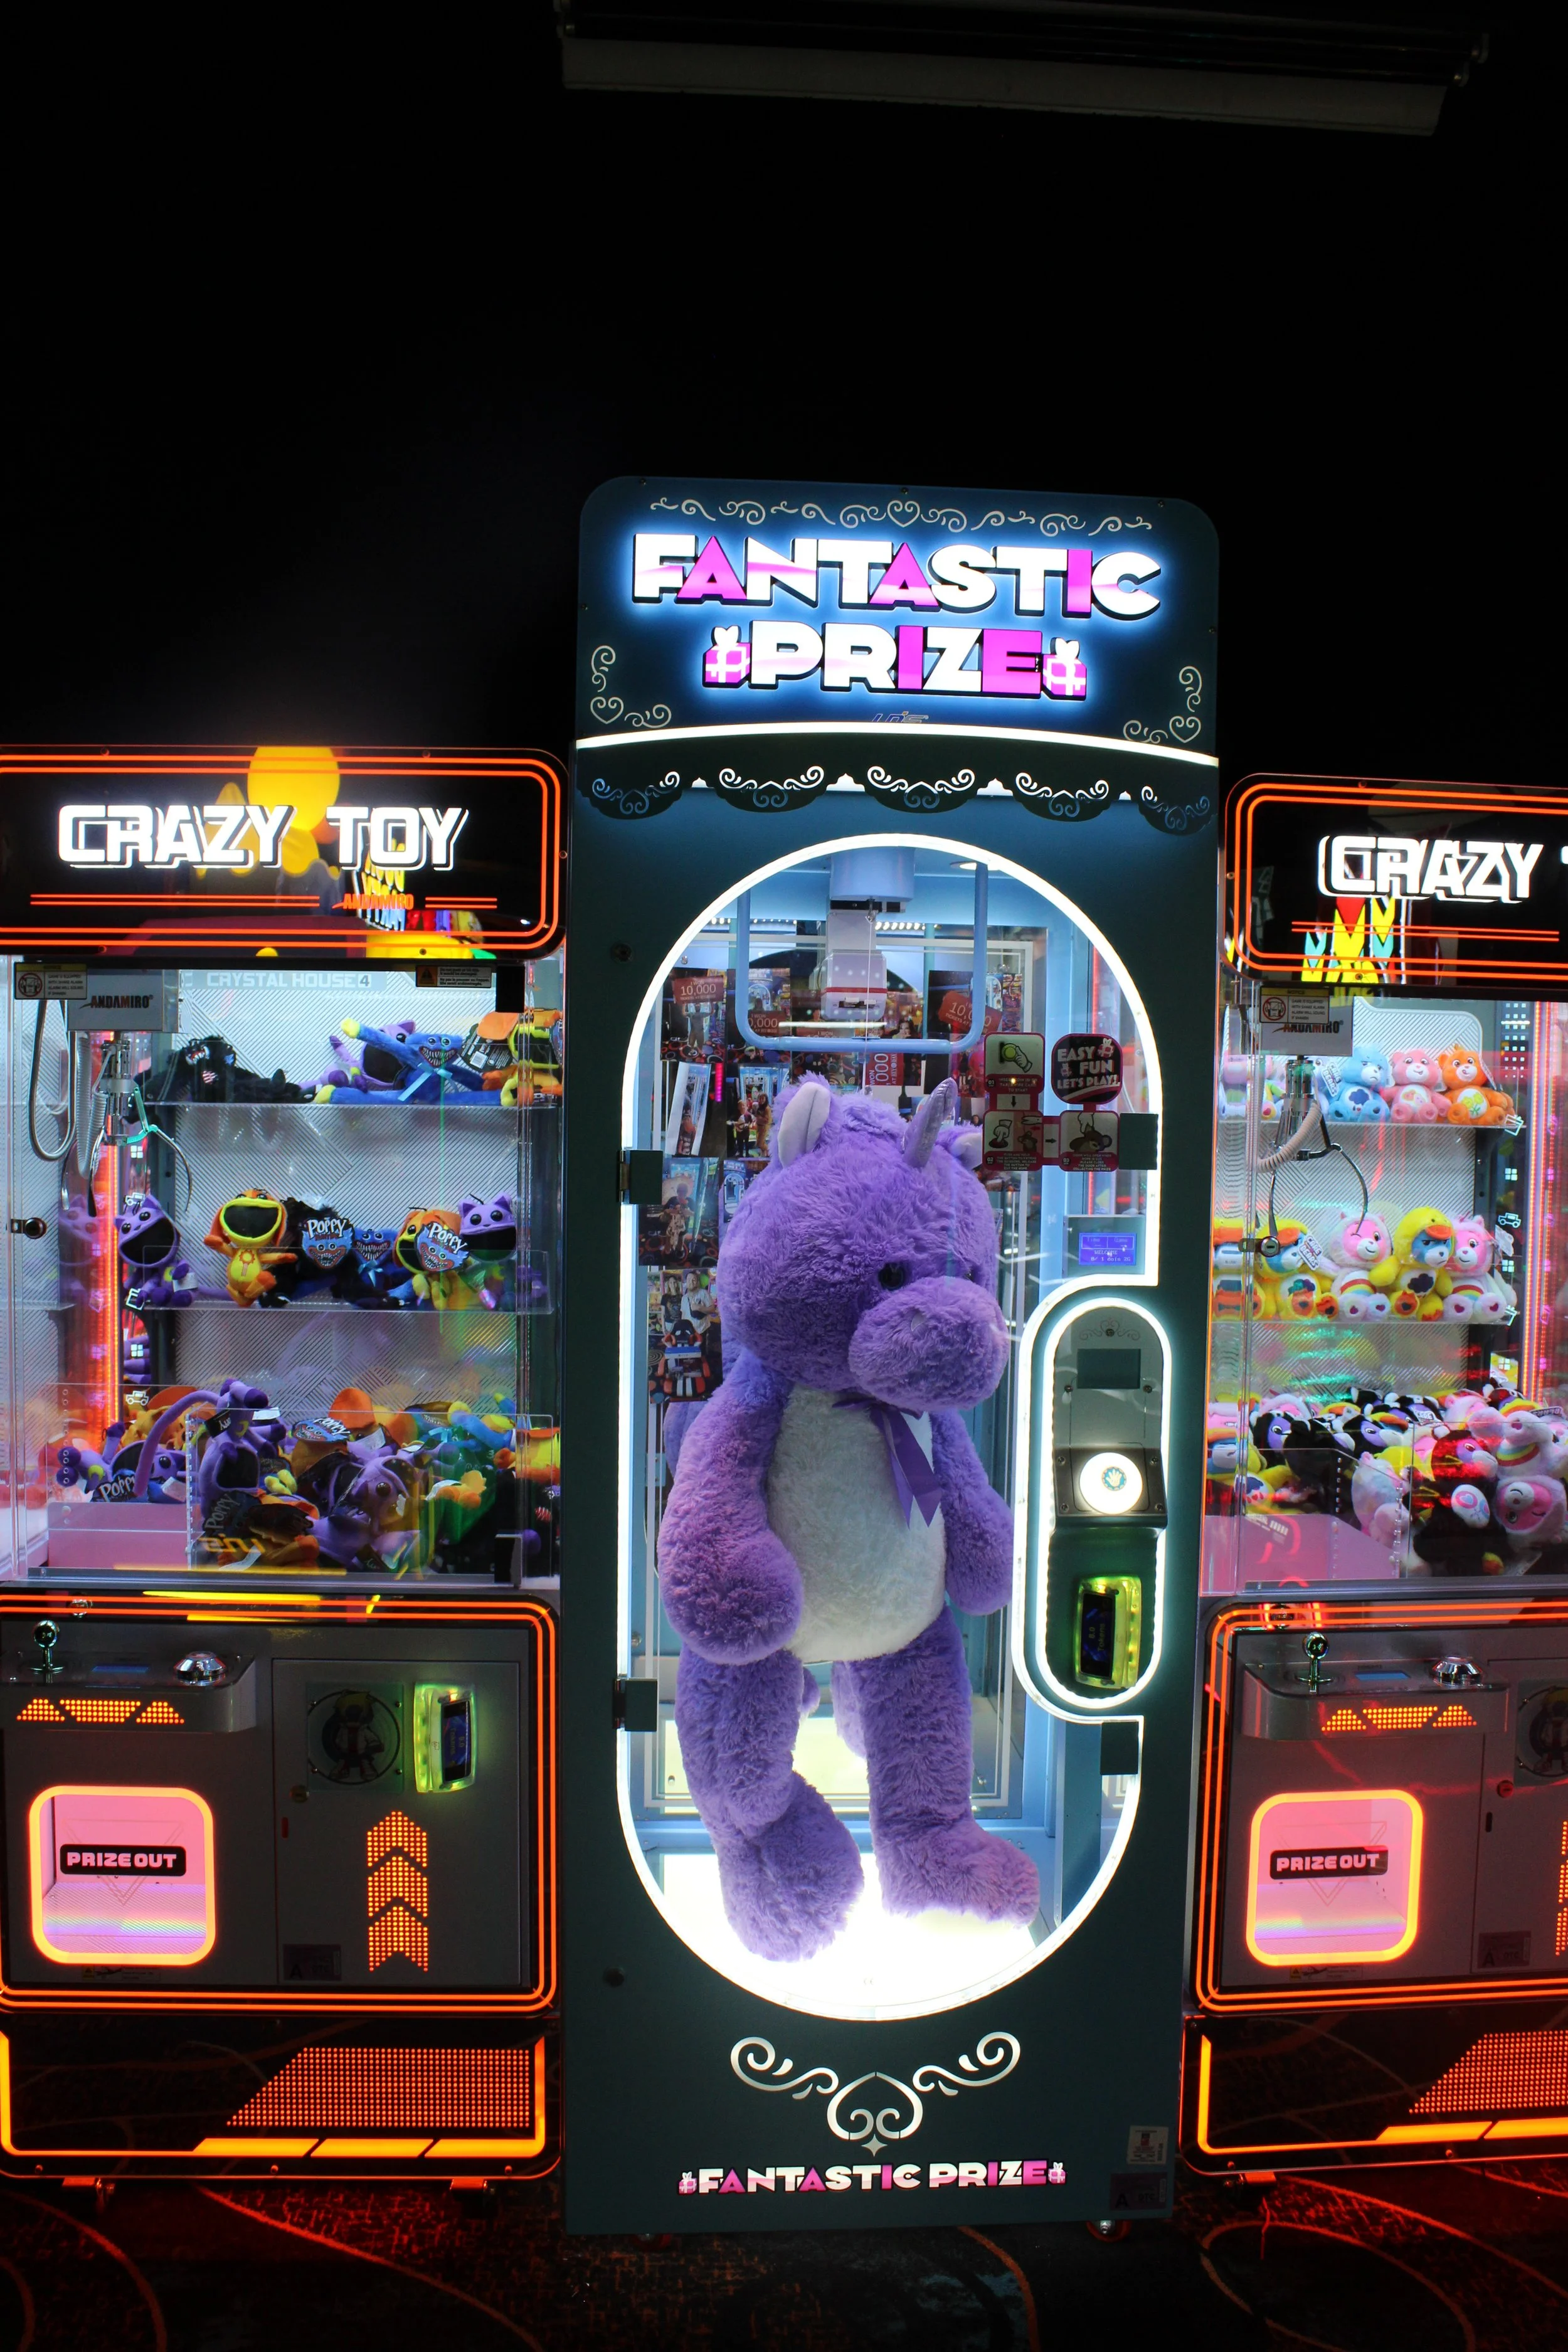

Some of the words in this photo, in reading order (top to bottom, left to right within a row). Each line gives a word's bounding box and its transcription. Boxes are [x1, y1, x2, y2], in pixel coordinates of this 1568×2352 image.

[633, 534, 1161, 618] FANTASTIC
[750, 620, 1042, 696] PRIZE
[59, 805, 297, 868] CRAZY
[326, 807, 469, 871] TOY
[1318, 835, 1544, 904] CRAZY
[334, 893, 415, 909] ANDAMIRO
[207, 972, 287, 988] CRYSTAL
[292, 973, 356, 988] HOUSE
[681, 983, 716, 996] 10,000
[748, 1018, 778, 1029] 0,000
[1057, 1046, 1095, 1062] EASY
[1079, 1059, 1113, 1075] FUN
[1057, 1077, 1084, 1089] LET'S
[1097, 1623, 1105, 1652] Tokens
[67, 1851, 132, 1867] PRIZE
[134, 1853, 177, 1868] OUT
[1276, 1855, 1337, 1872] PRIZE
[1339, 1853, 1379, 1869] OUT
[698, 2164, 922, 2193] FANTASTIC
[929, 2160, 1047, 2188] PRIZE
